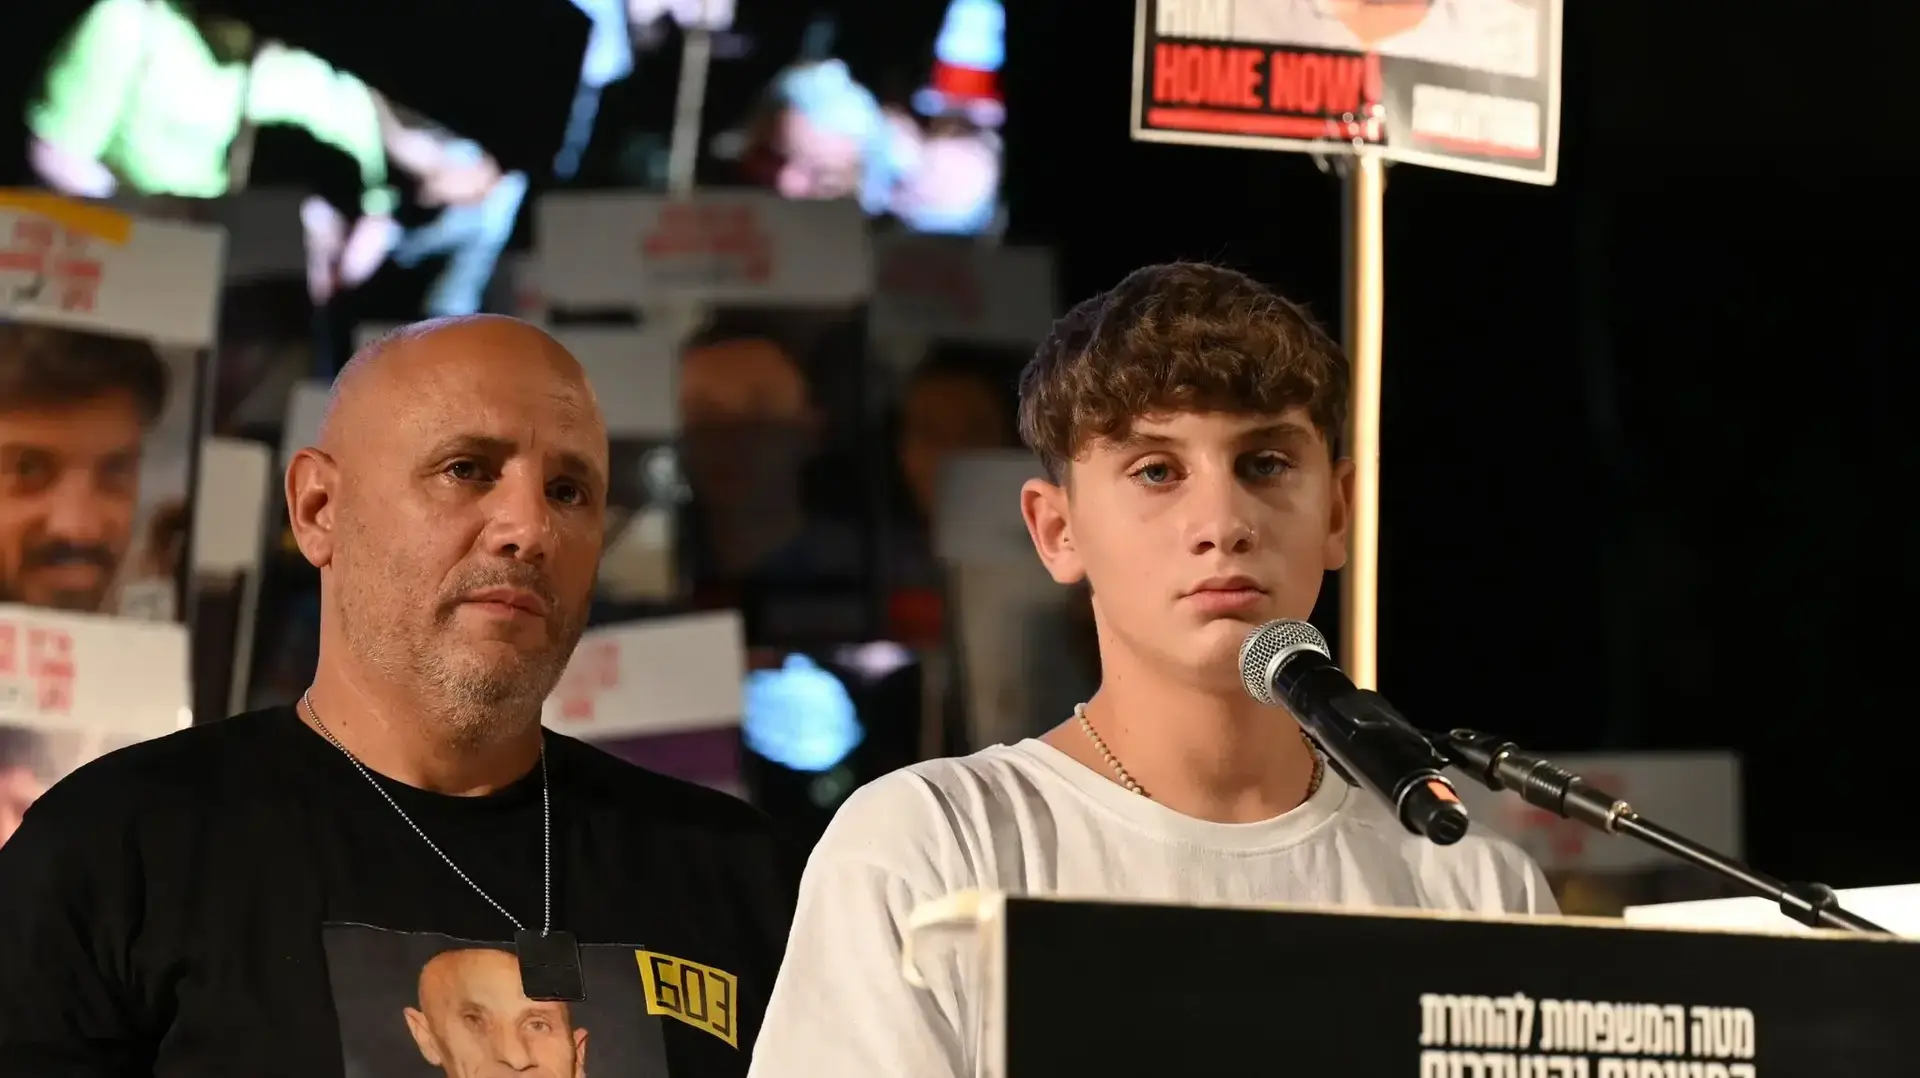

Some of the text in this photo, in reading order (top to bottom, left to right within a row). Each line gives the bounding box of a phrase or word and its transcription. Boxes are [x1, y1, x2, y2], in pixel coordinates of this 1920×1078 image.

[1154, 43, 1265, 108] HOME
[650, 956, 732, 1038] 603
[1418, 991, 1756, 1060] מטה המשפחות להחזרת
